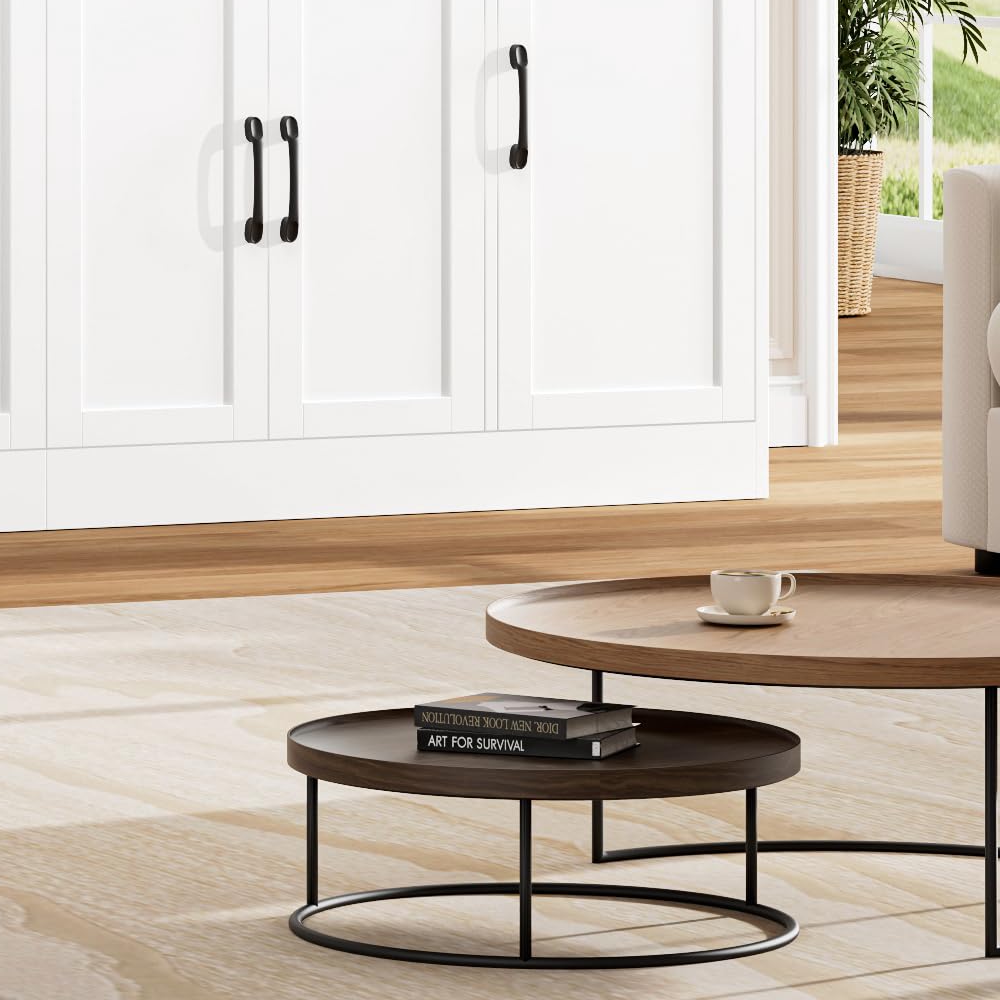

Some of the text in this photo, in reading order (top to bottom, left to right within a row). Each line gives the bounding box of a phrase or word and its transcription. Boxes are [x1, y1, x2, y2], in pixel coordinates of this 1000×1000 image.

[421, 711, 480, 728] REVOLUTION
[482, 716, 508, 730] LOOK
[510, 719, 532, 732] NEW
[427, 735, 525, 752] ART FOR SURVIVAL
